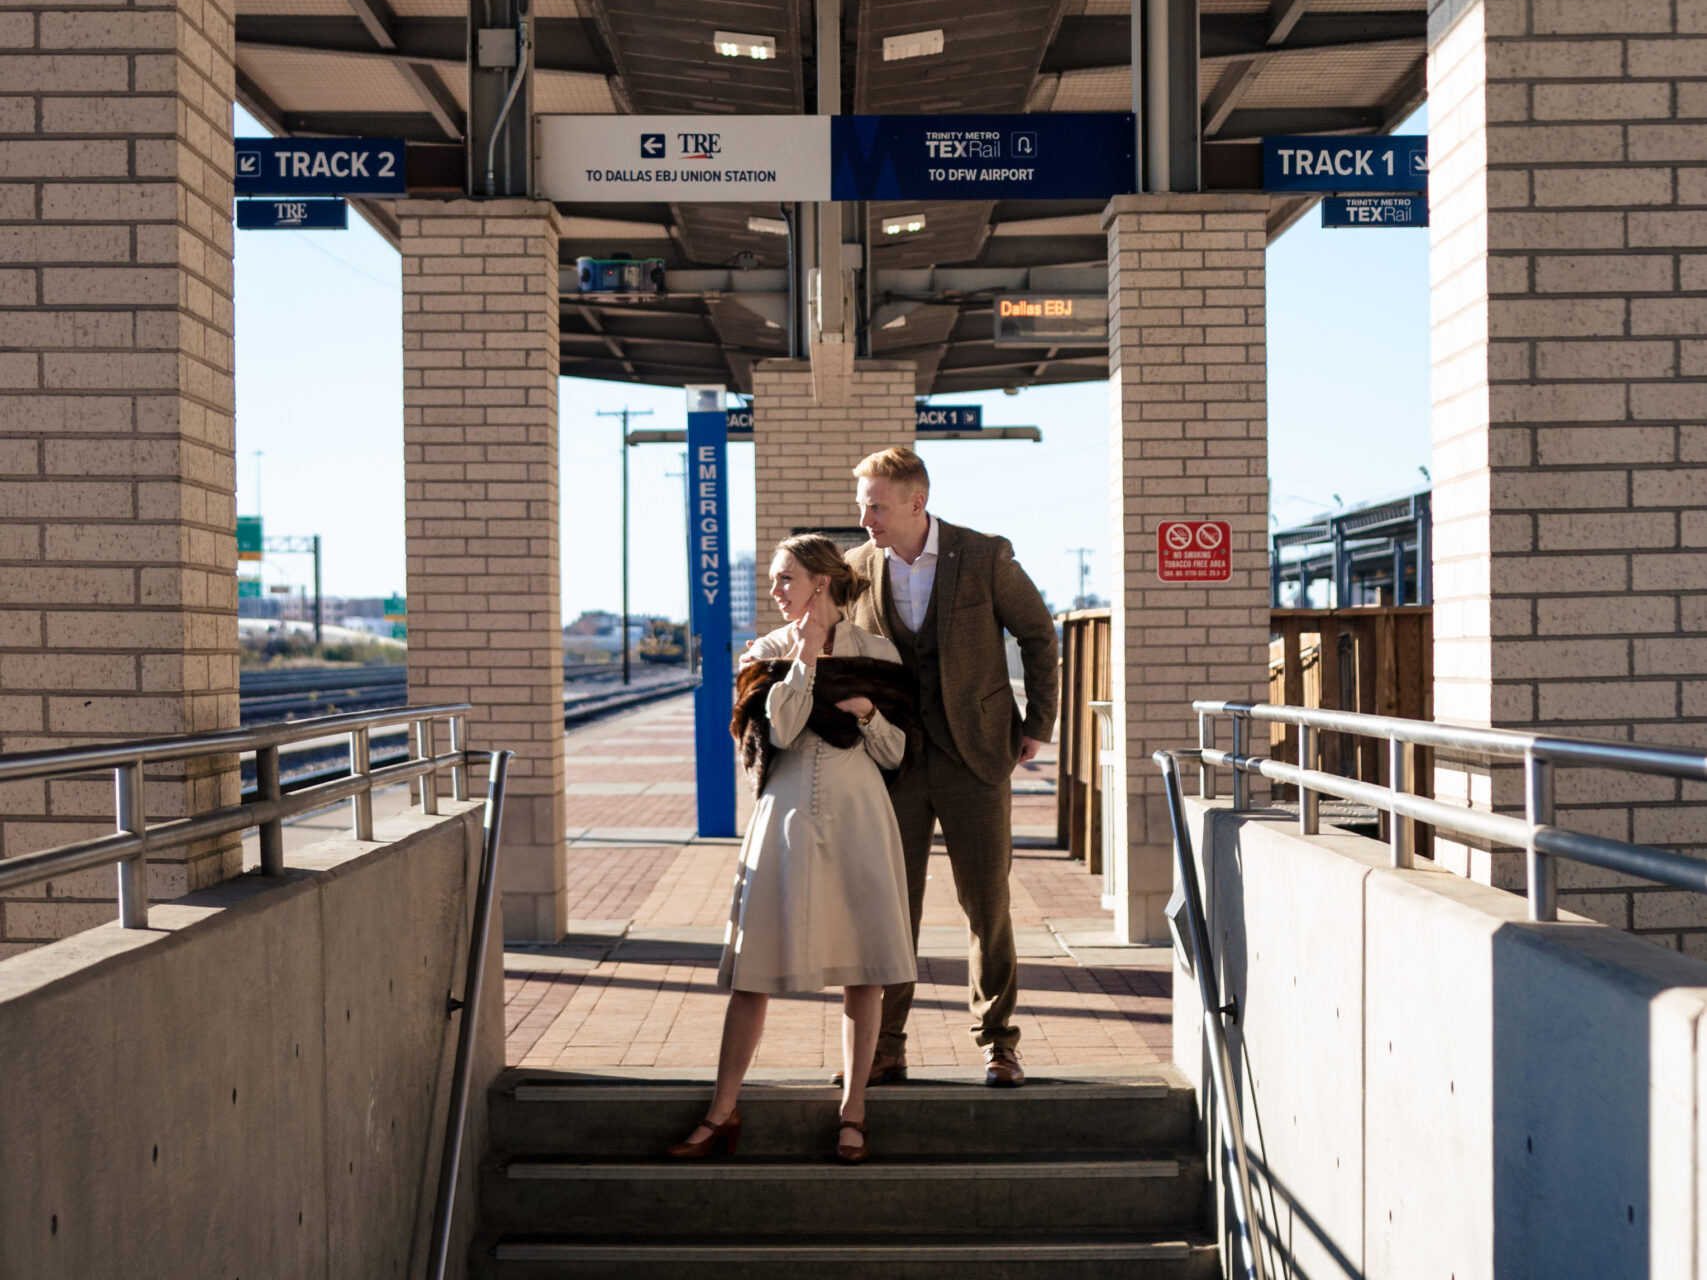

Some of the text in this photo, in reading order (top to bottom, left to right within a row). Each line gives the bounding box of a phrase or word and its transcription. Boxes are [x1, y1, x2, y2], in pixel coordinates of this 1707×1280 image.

[926, 131, 1000, 140] TRINITY METRO
[677, 133, 722, 158] TRE
[925, 140, 1001, 158] TEXRail
[274, 151, 396, 177] TRACK 2
[1277, 149, 1394, 176] TRACK 1
[586, 170, 777, 182] TO DALLAS EBJ UNION STATION
[928, 169, 1035, 181] TO DFW AIRPORT
[1346, 198, 1411, 206] TRINITY METRO
[274, 202, 308, 220] TRE
[1346, 206, 1412, 222] TEXRail
[1000, 299, 1072, 317] Dallas EBJ
[916, 410, 958, 425] ACK 1
[698, 446, 720, 605] EMERGENCY
[1173, 551, 1182, 559] NO
[1184, 551, 1211, 559] SMOKING
[1164, 560, 1226, 568] TOBACCO FREE AREA
